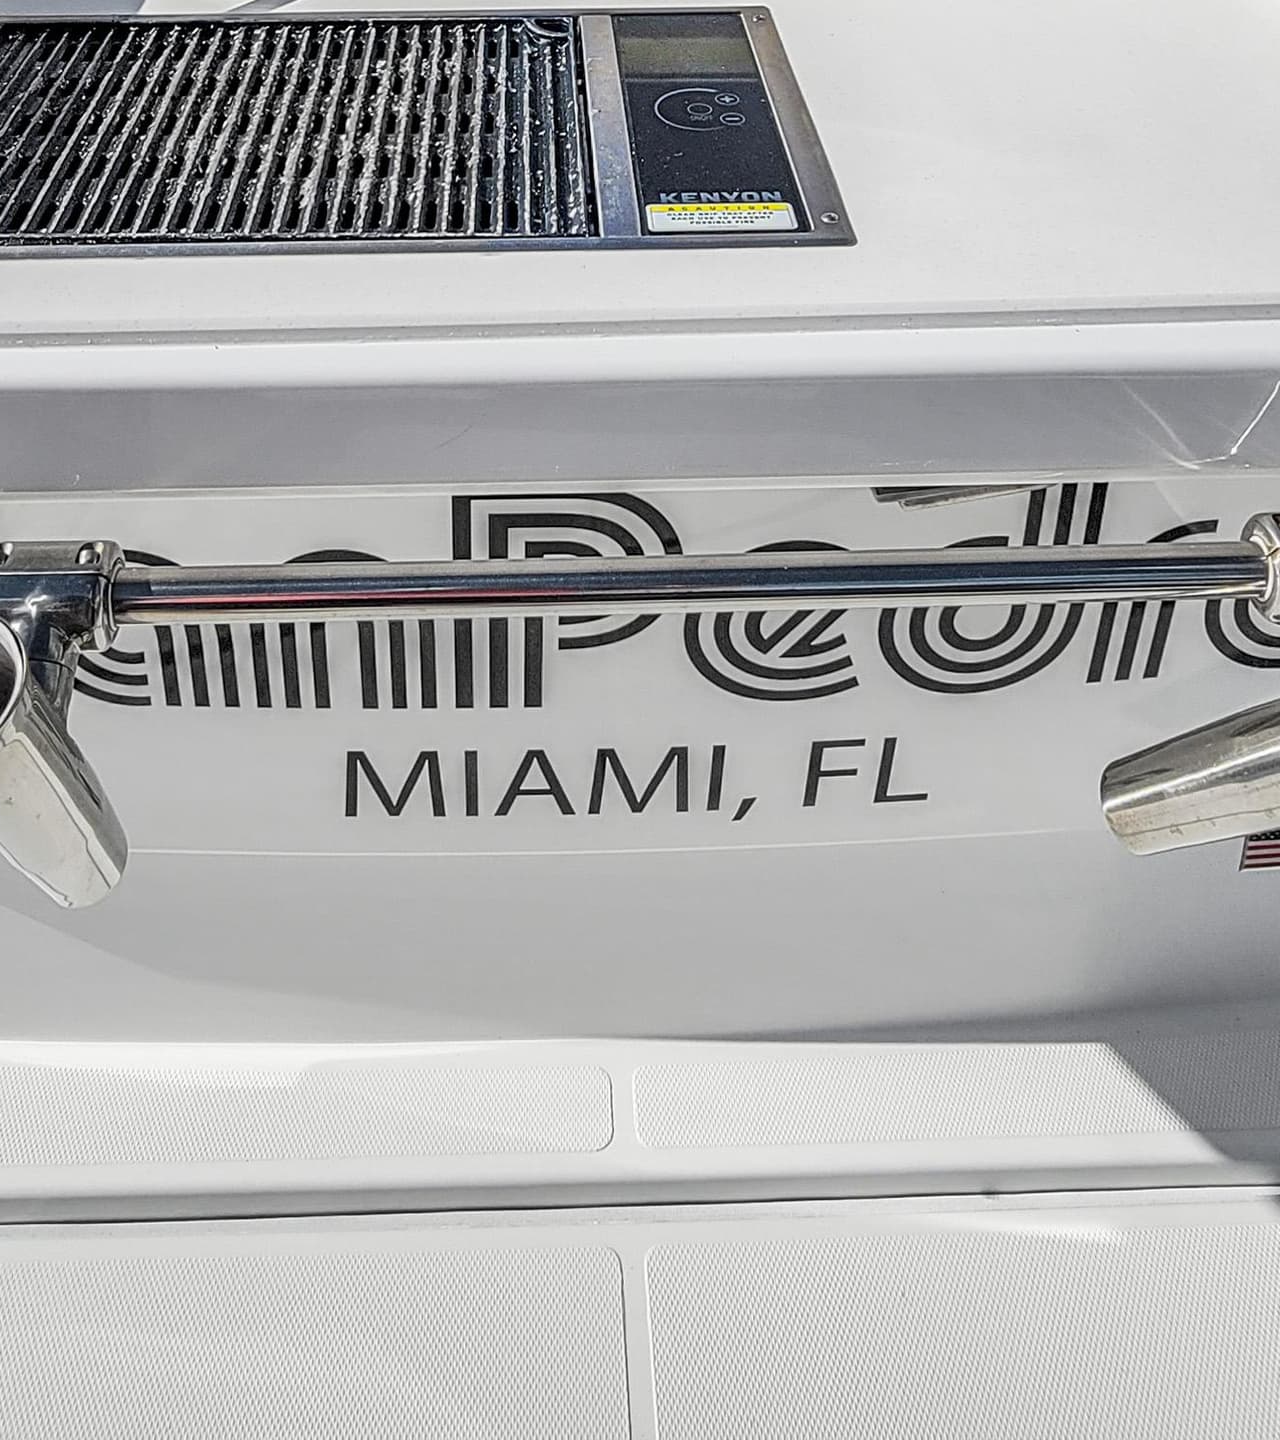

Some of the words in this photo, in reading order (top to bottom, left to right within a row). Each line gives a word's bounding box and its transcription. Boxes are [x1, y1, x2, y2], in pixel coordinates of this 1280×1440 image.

[659, 191, 782, 203] KENYON
[344, 745, 758, 822] MIAMI,
[801, 737, 929, 807] FL
